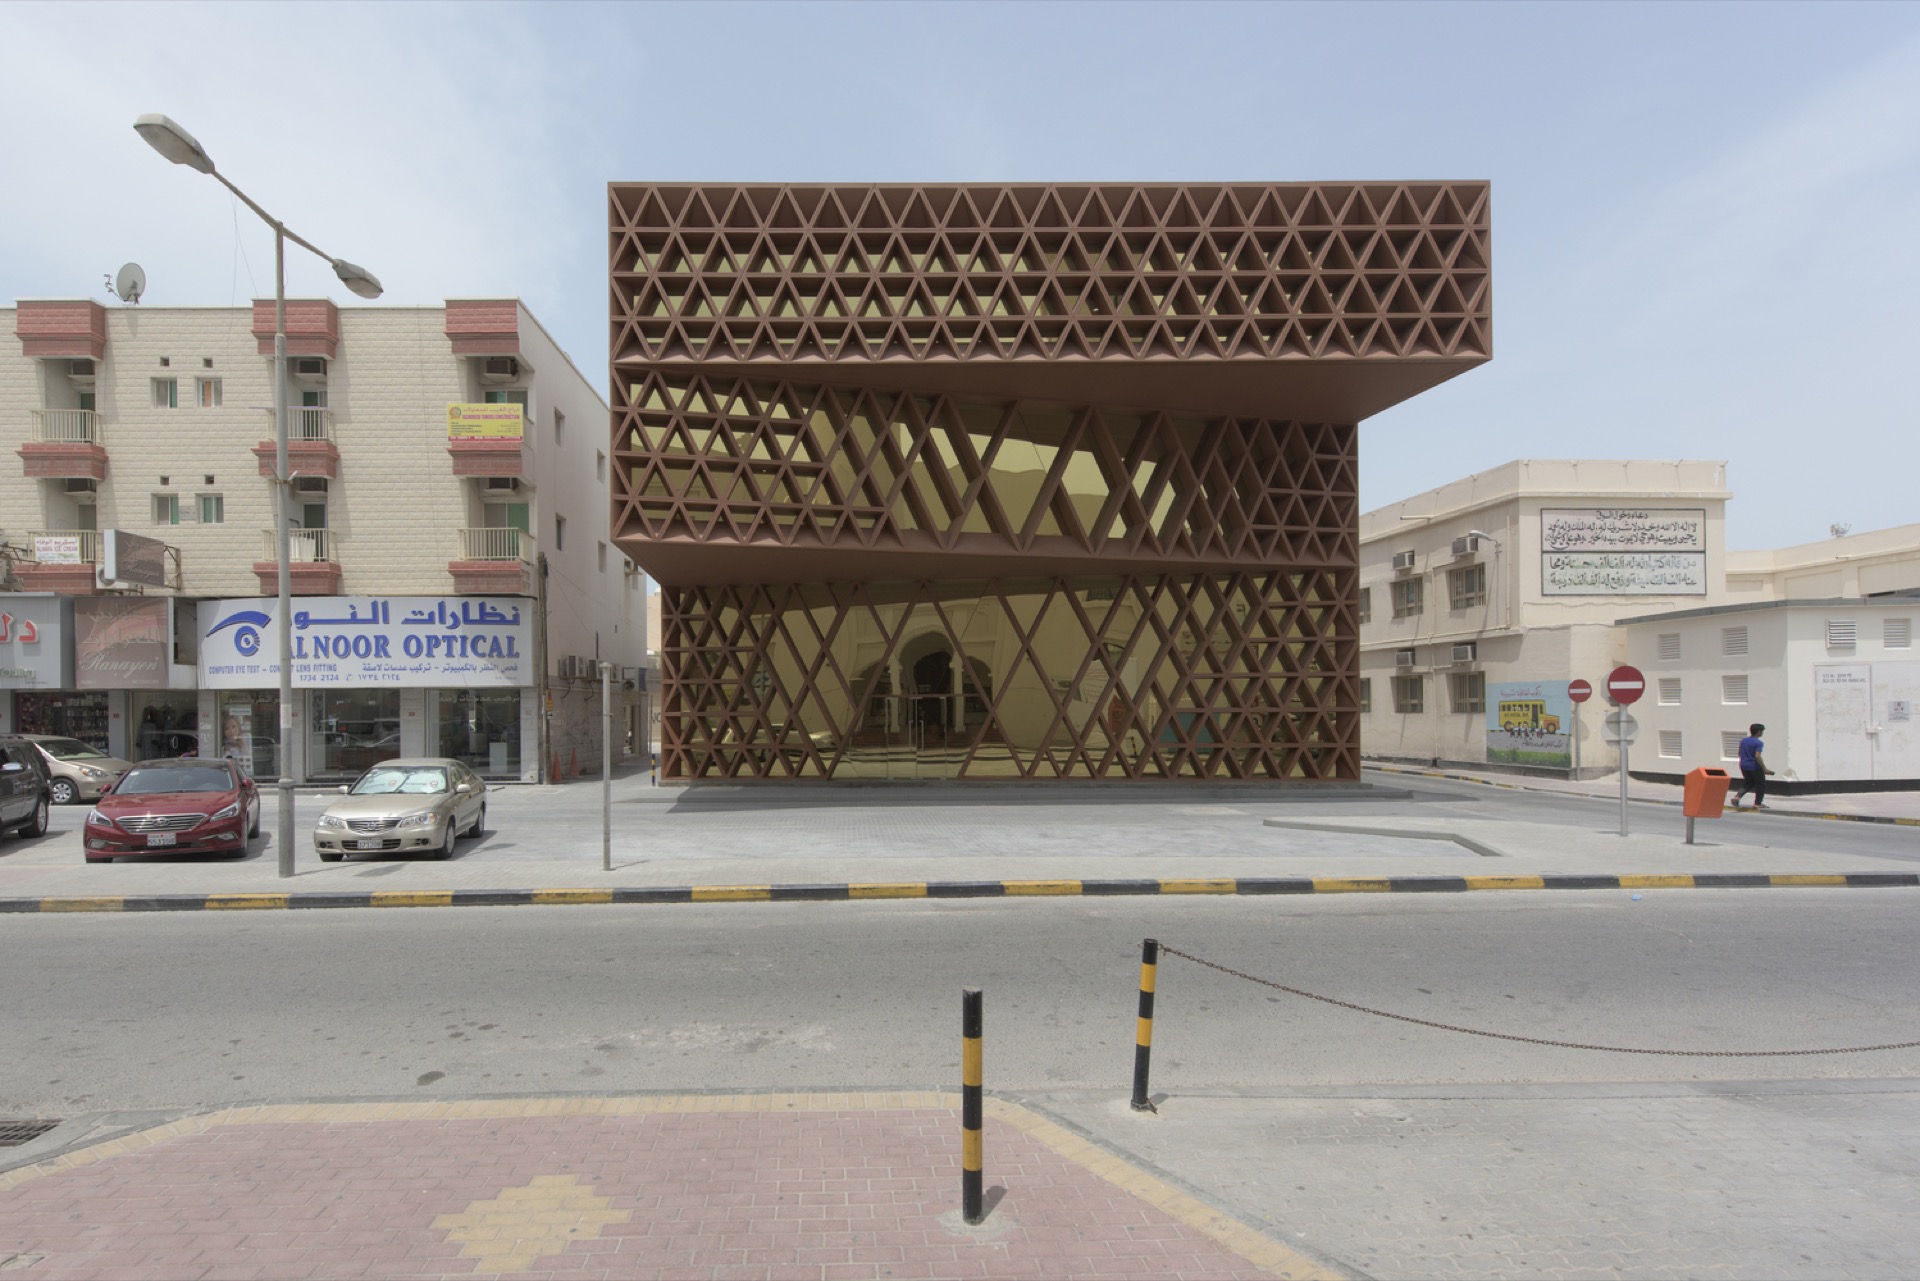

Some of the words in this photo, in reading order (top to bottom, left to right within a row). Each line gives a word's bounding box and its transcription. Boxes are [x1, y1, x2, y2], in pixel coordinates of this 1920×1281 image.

[290, 600, 390, 630] النو
[401, 600, 521, 630] نظارات
[313, 634, 392, 659] NOOR
[403, 634, 520, 659] OPTICAL
[82, 651, 160, 678] Hanayen
[208, 665, 234, 675] COMPUTER
[235, 665, 246, 674] EYE
[246, 665, 260, 674] TEST
[269, 664, 294, 674] CONT
[296, 664, 311, 673] LENS
[313, 663, 338, 672] FITTING
[362, 662, 382, 672] لاصقة
[383, 663, 408, 672] عدسات
[409, 663, 432, 674] تركيب
[441, 663, 477, 674] بالكمبيوتر
[479, 664, 499, 674] النظر
[501, 663, 519, 674] فحص
